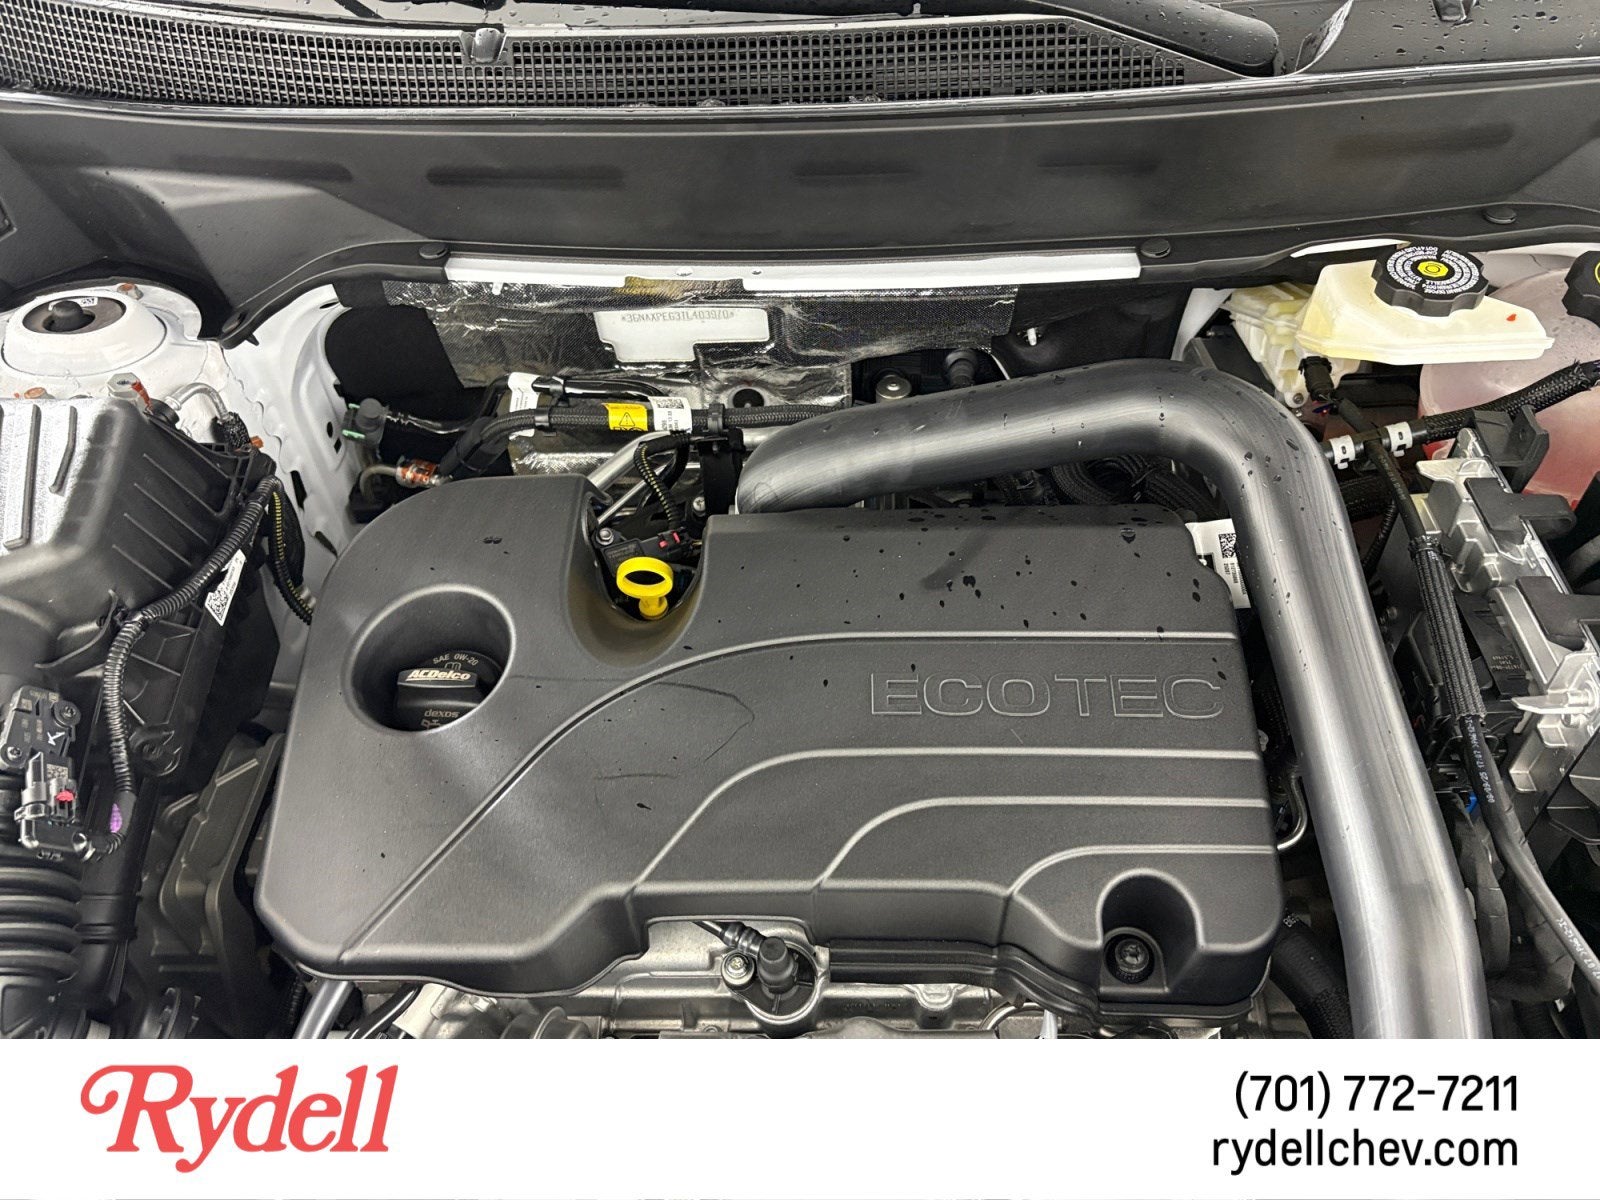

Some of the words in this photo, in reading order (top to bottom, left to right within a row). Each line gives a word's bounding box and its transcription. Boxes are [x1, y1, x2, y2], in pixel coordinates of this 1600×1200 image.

[432, 653, 450, 665] SAE
[453, 653, 479, 666] 0W-20
[405, 669, 471, 682] ACDelco
[870, 672, 1224, 720] ECOTEC
[424, 708, 460, 718] dexos
